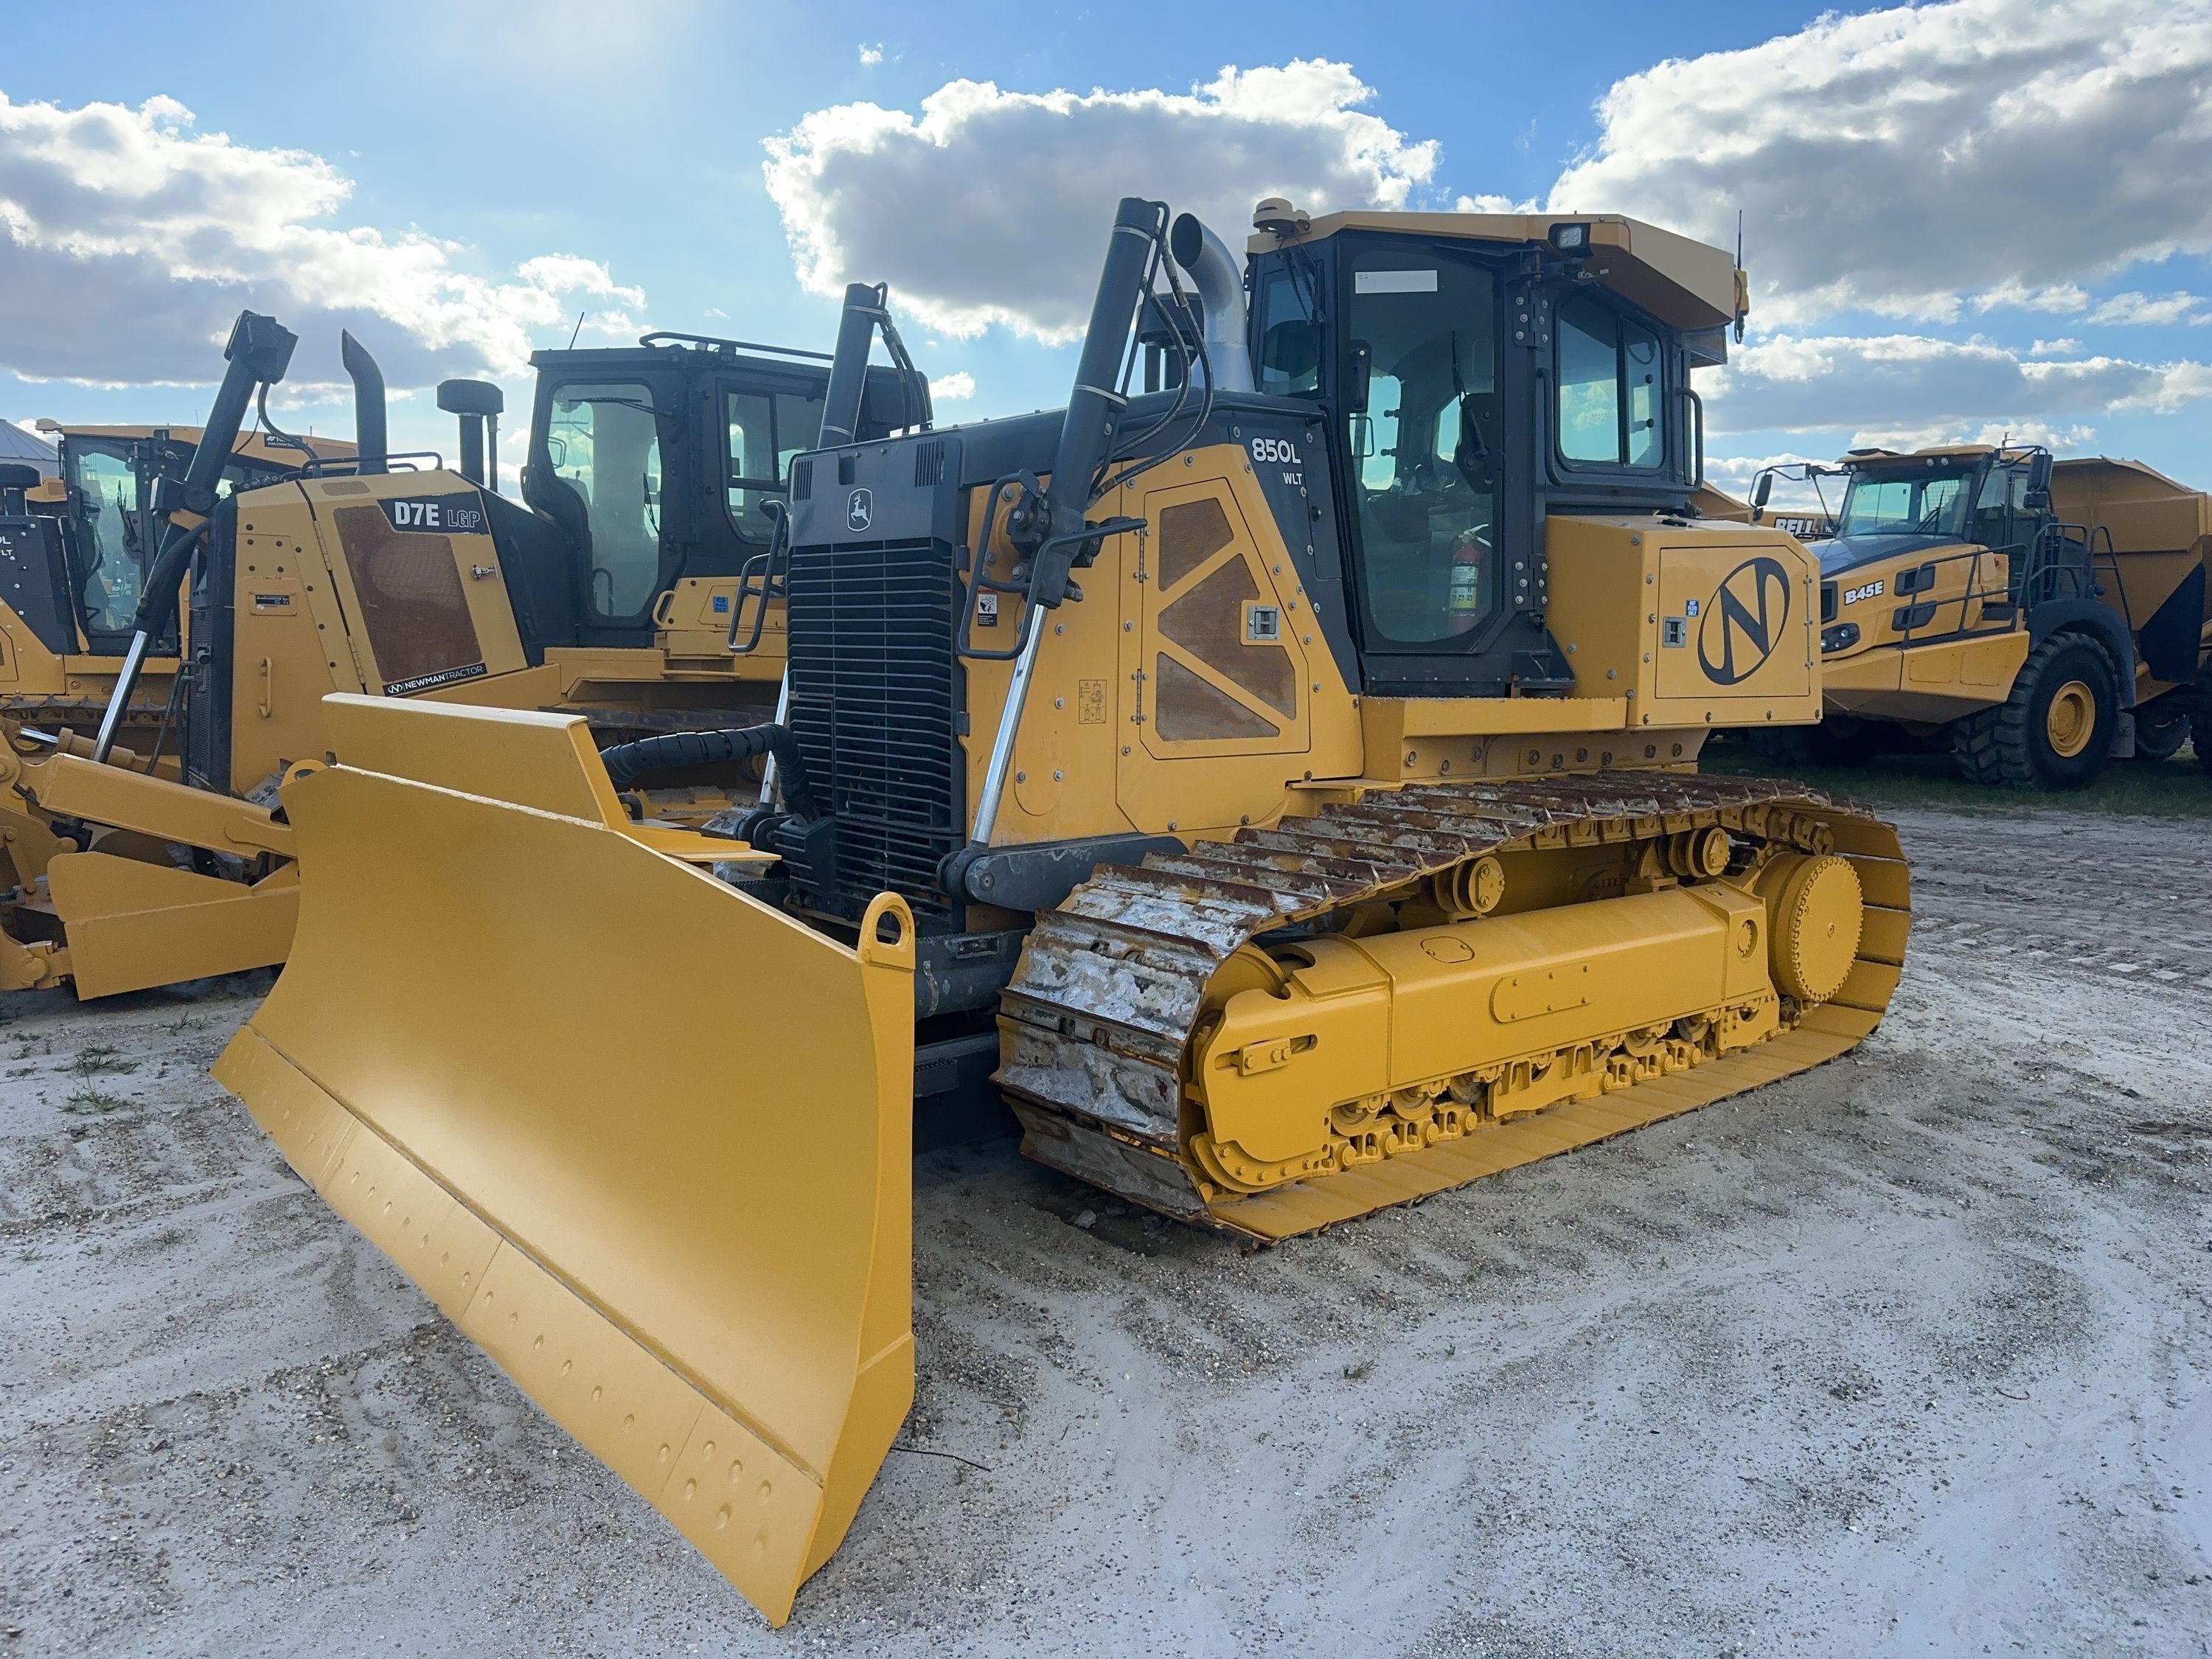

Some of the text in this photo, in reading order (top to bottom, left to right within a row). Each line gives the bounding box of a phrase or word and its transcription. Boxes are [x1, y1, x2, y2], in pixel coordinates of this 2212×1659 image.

[1252, 438, 1301, 463] 850L
[1283, 472, 1302, 484] WLT
[394, 501, 480, 527] D7E LGP
[1845, 580, 1883, 605] B45E
[405, 666, 484, 689] NEWMANTRACTOR
